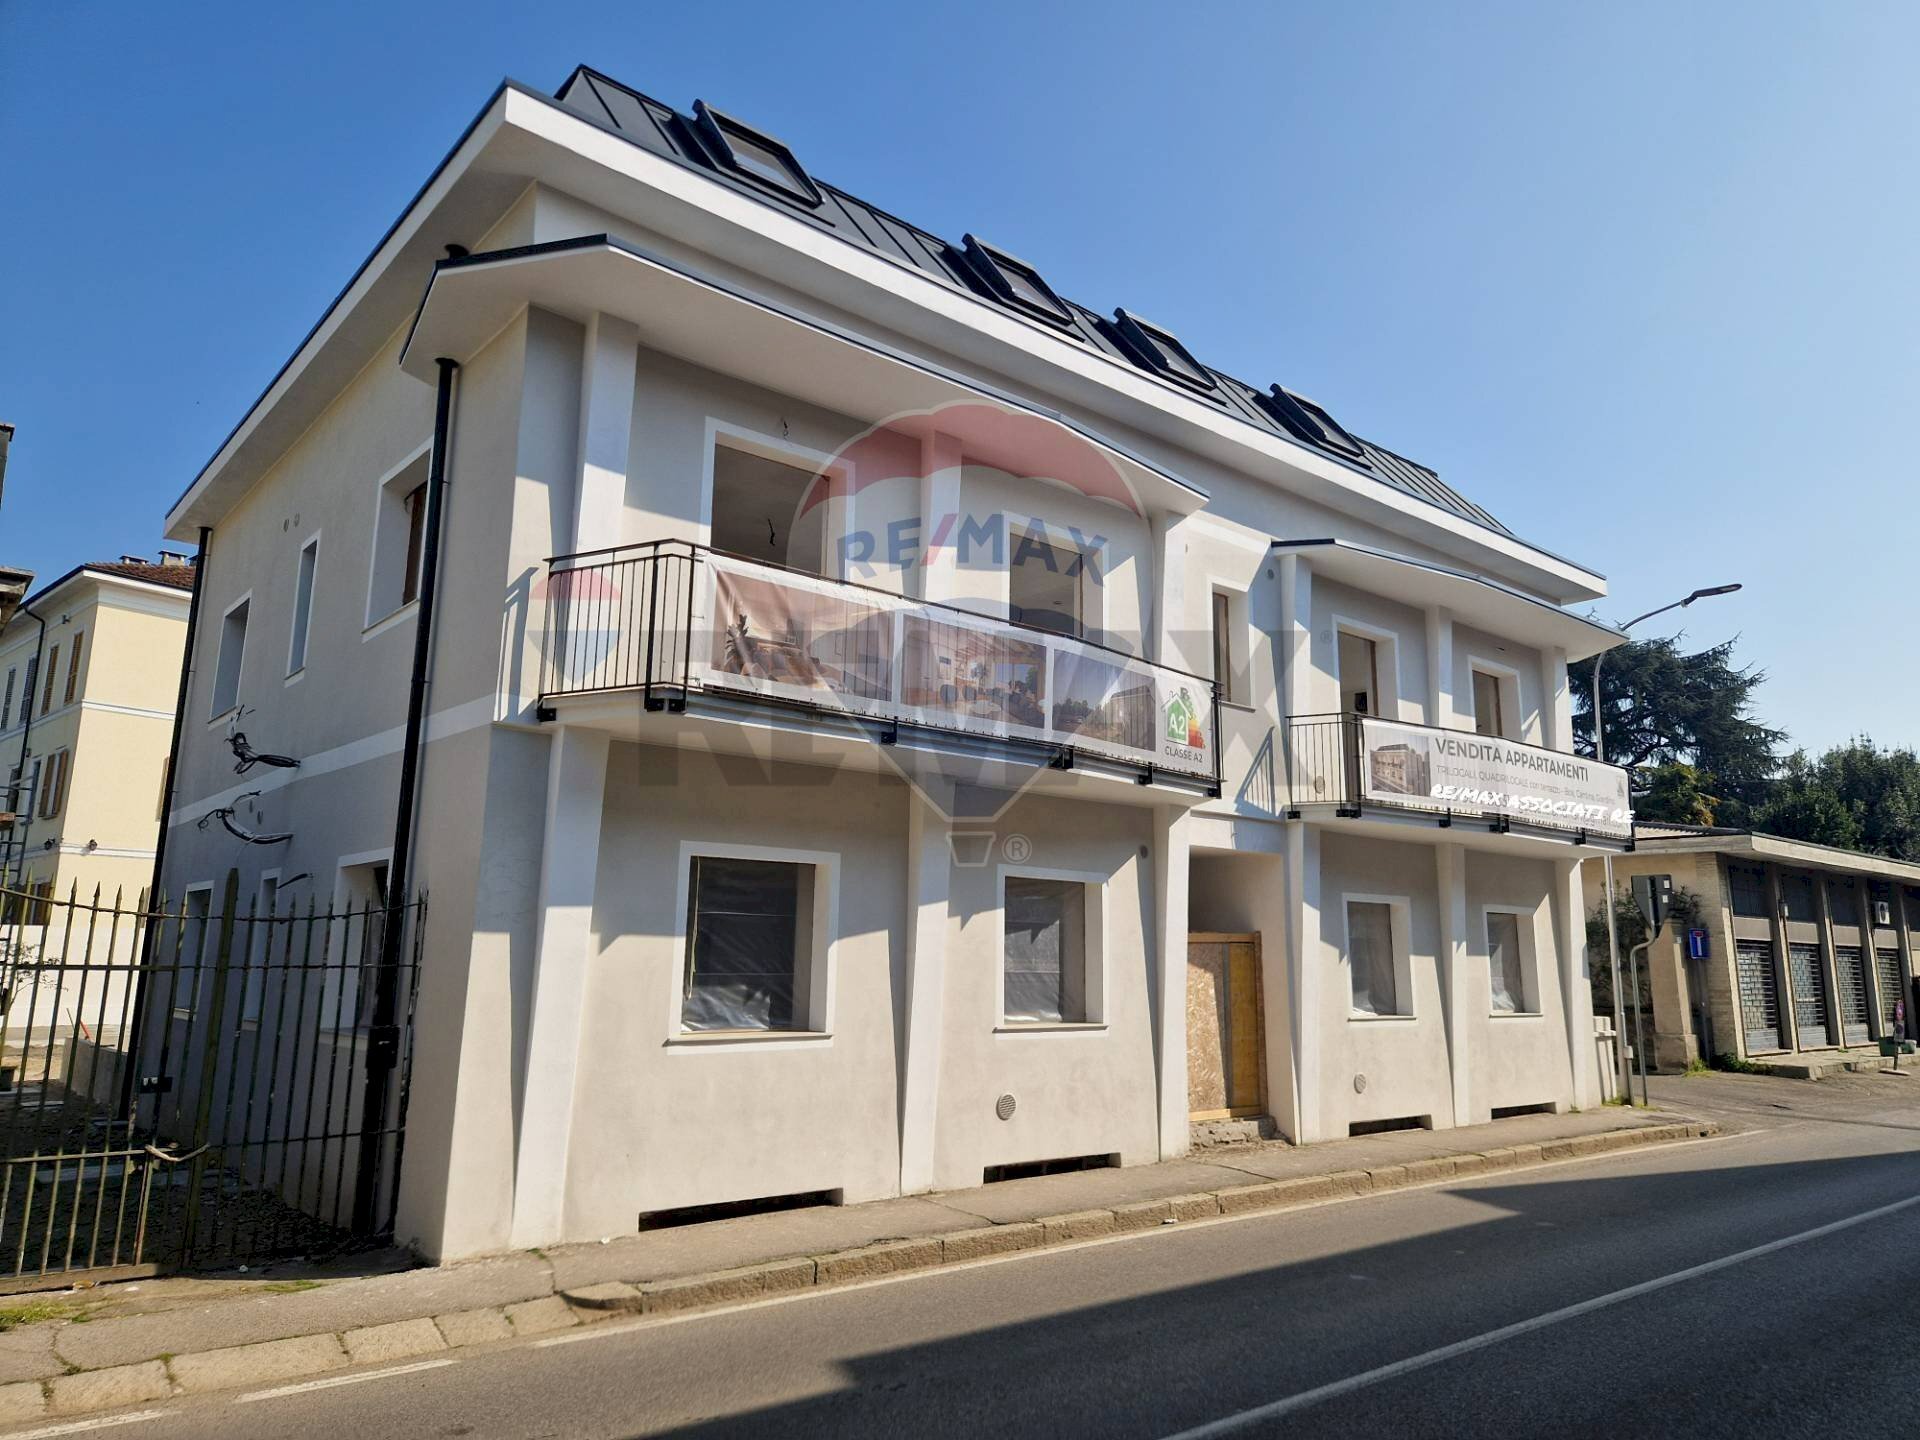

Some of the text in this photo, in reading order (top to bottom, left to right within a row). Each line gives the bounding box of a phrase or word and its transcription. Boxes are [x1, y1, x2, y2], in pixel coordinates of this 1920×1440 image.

[1168, 713, 1186, 735] A2
[1164, 745, 1203, 763] CLASSE A2
[1435, 737, 1588, 782] VENDITA APPARTAMENTI
